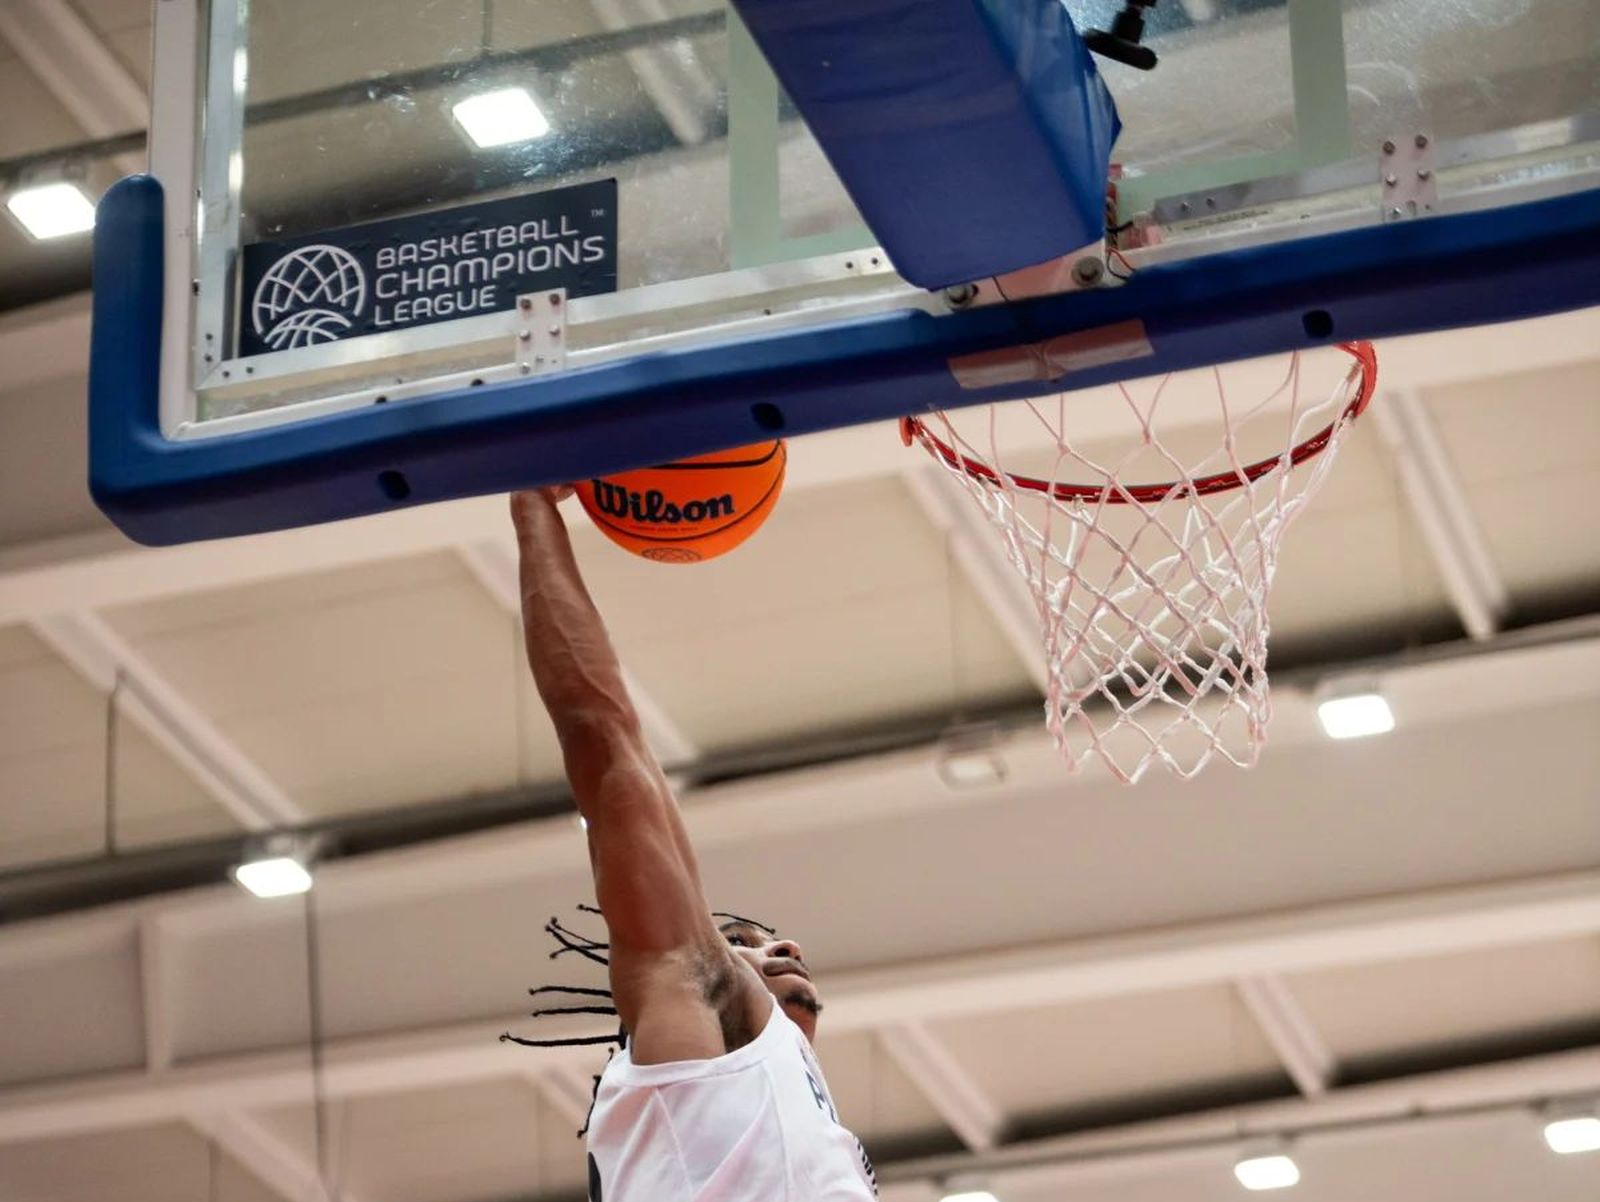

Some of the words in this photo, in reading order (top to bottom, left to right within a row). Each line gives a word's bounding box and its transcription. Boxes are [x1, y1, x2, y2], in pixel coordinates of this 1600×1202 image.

[375, 235, 605, 299] CHAMPIONS
[376, 215, 579, 270] BASKETBALL
[374, 285, 496, 326] LEAGUE
[592, 479, 735, 523] Wilson
